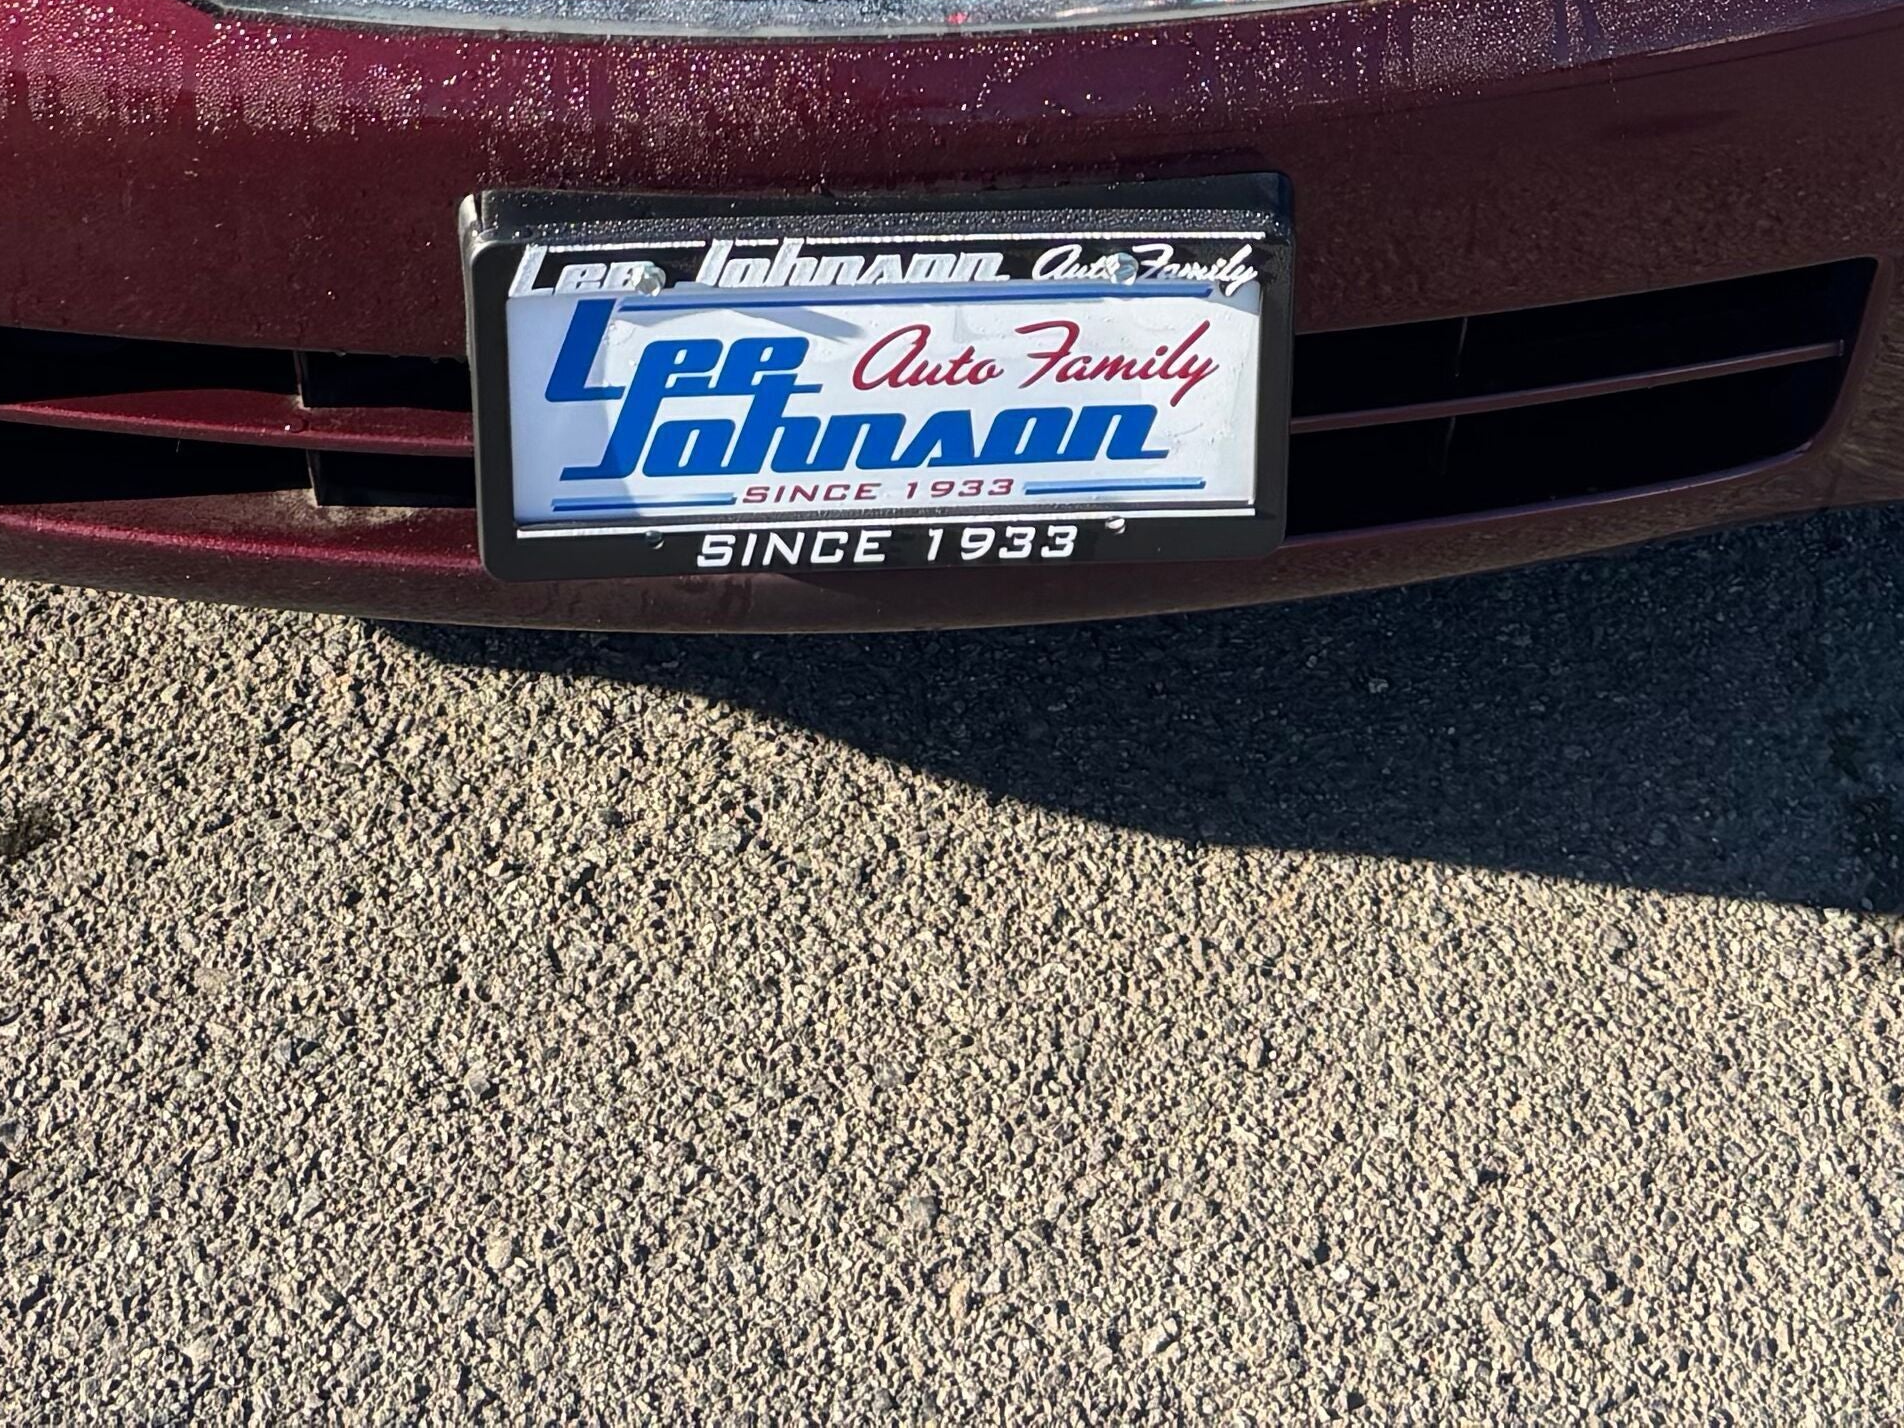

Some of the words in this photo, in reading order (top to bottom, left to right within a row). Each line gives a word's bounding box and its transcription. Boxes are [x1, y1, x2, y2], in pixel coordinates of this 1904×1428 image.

[696, 236, 1011, 290] Johnson
[1132, 243, 1258, 296] Family
[545, 298, 823, 403] Lee
[852, 324, 1005, 390] Auto
[1014, 319, 1220, 408] Family
[559, 372, 1170, 482] Johnson
[742, 482, 883, 504] SINCE
[906, 477, 1016, 500] 1933
[696, 529, 893, 568] SINCE
[927, 524, 1079, 562] 1933
